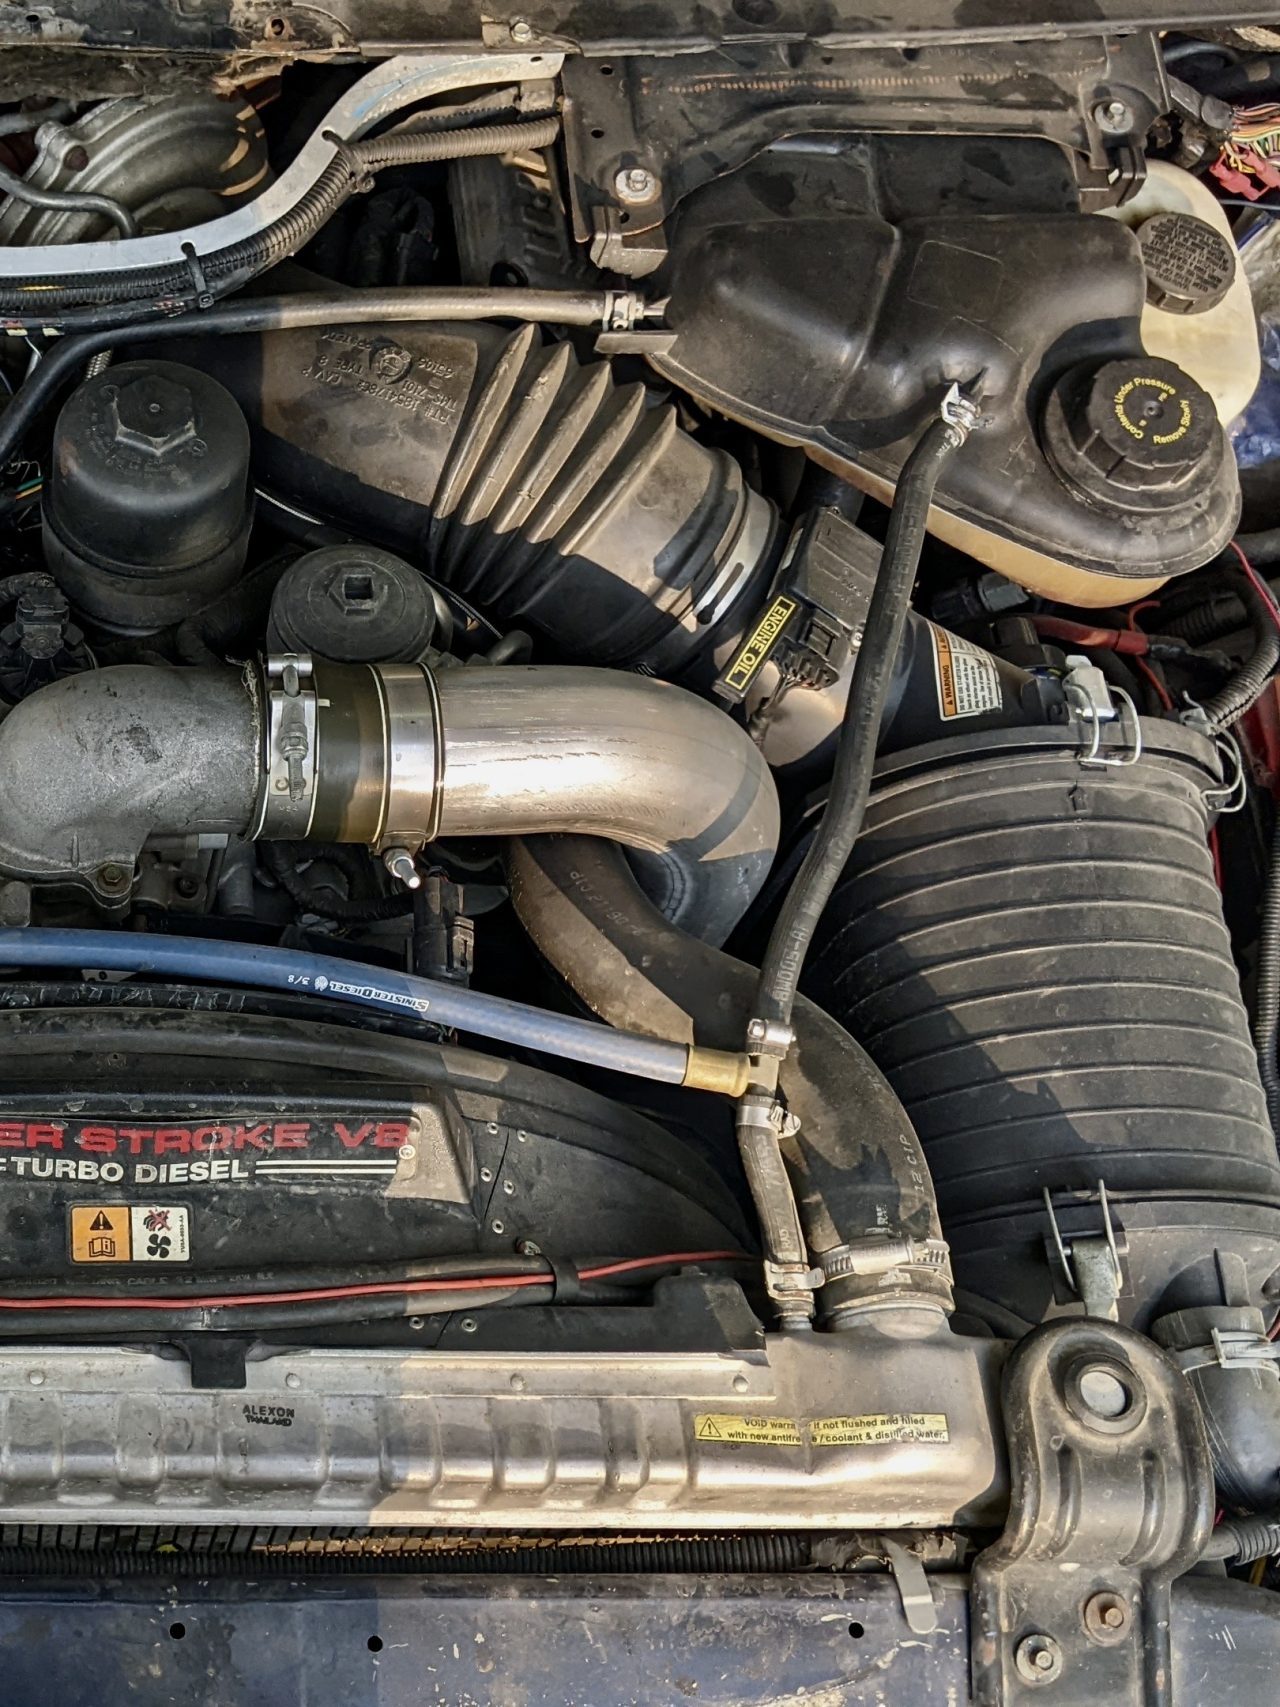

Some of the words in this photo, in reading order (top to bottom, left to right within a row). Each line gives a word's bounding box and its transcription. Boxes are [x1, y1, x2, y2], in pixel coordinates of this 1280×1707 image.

[1113, 381, 1134, 403] Under
[1133, 377, 1176, 395] Pressure
[1114, 404, 1144, 439] Contents
[1153, 426, 1187, 444] Remove
[1180, 400, 1191, 427] Slowly
[751, 605, 788, 652] ENGINE
[733, 653, 756, 675] OIL
[942, 664, 953, 698] WARNING
[287, 973, 309, 987] 3/8
[80, 1123, 310, 1154] STROKE
[334, 1123, 411, 1148] V8
[10, 1156, 123, 1183] TURBO
[135, 1159, 249, 1183] DIESEL
[242, 1404, 295, 1418] ALEXON
[744, 1418, 767, 1428] VOID
[813, 1420, 820, 1429] if
[823, 1420, 839, 1429] not
[841, 1419, 877, 1429] flushed
[880, 1417, 899, 1426] and
[901, 1415, 925, 1425] filled
[727, 1430, 748, 1440] with
[750, 1432, 770, 1441] new
[771, 1432, 818, 1443] antifree
[820, 1434, 825, 1444] /
[826, 1432, 862, 1442] coolant
[865, 1432, 873, 1441] &
